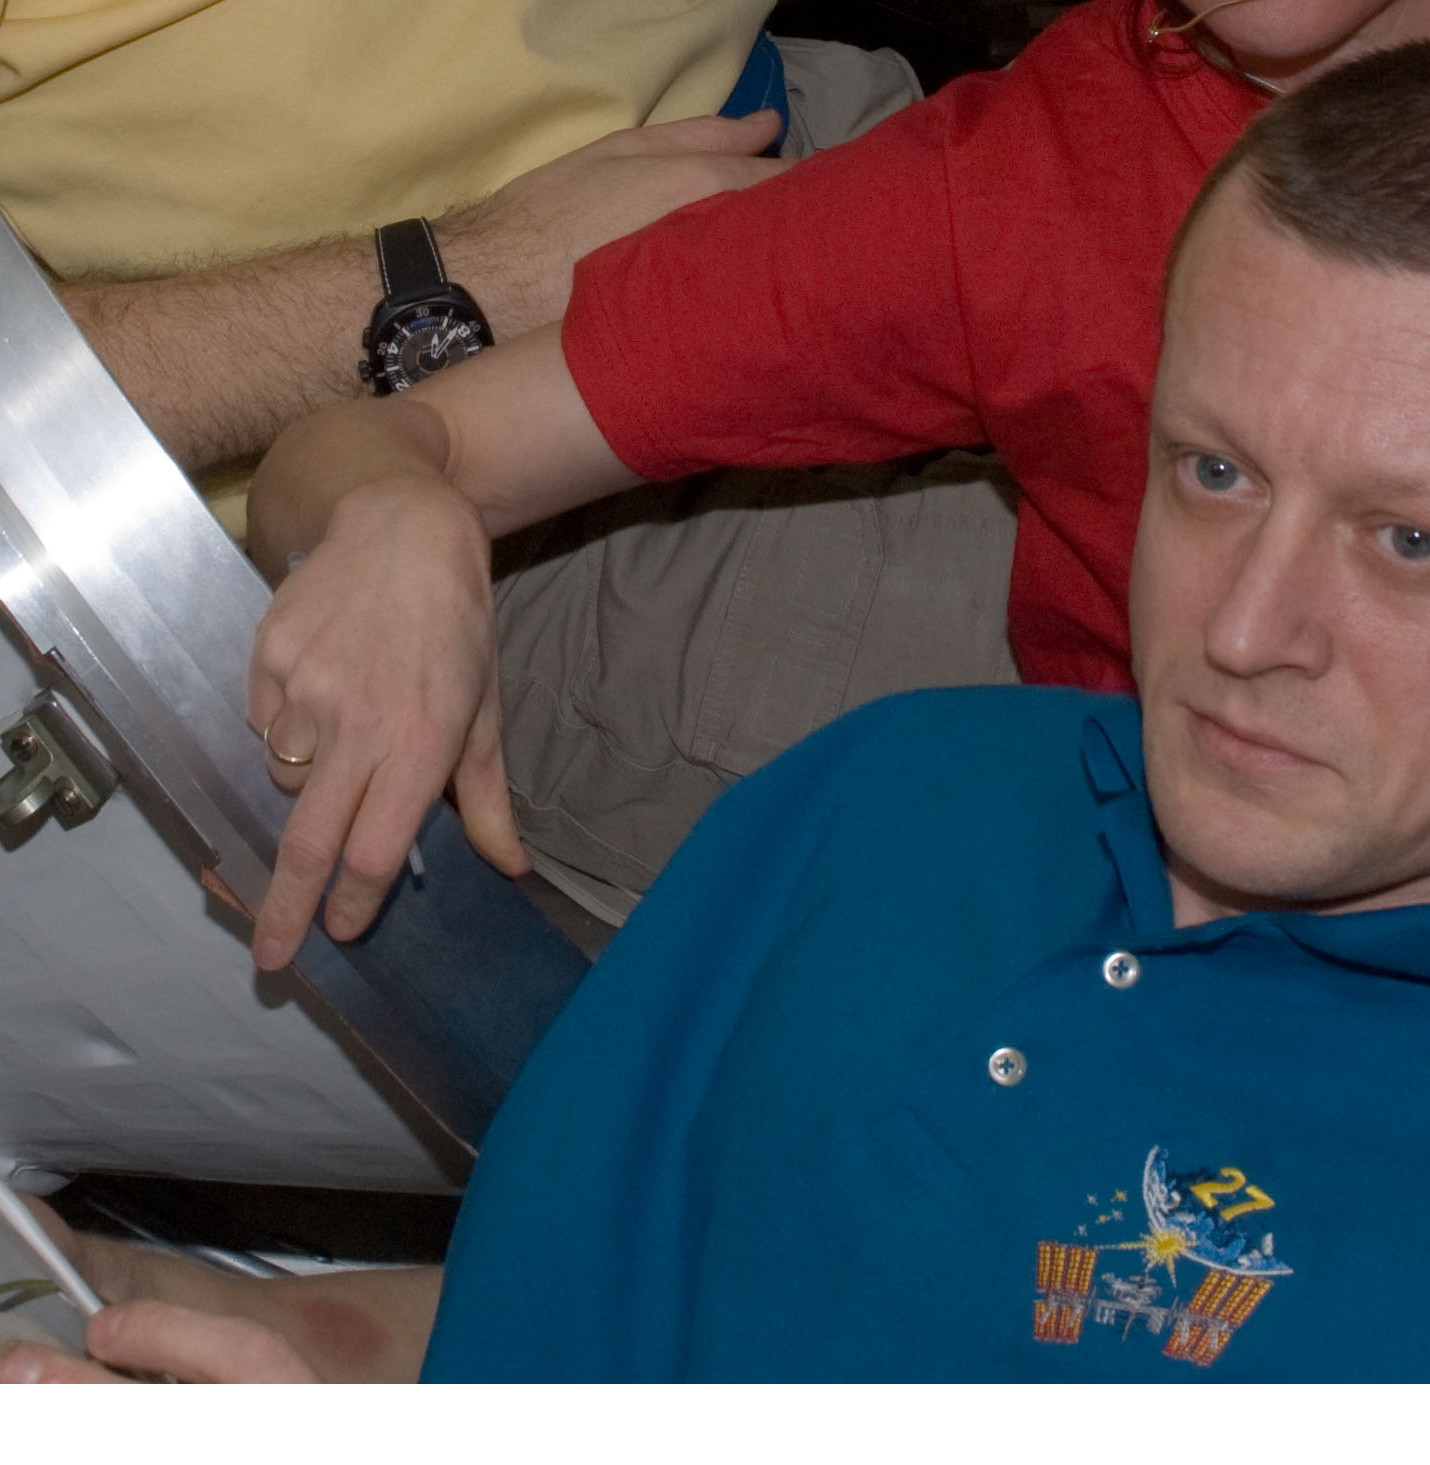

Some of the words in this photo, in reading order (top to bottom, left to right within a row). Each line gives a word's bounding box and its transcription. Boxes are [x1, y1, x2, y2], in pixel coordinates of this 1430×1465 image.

[416, 307, 430, 317] 30
[457, 323, 471, 337] 8
[377, 341, 388, 355] 20
[387, 341, 399, 354] 4
[1189, 1166, 1276, 1222] 27
